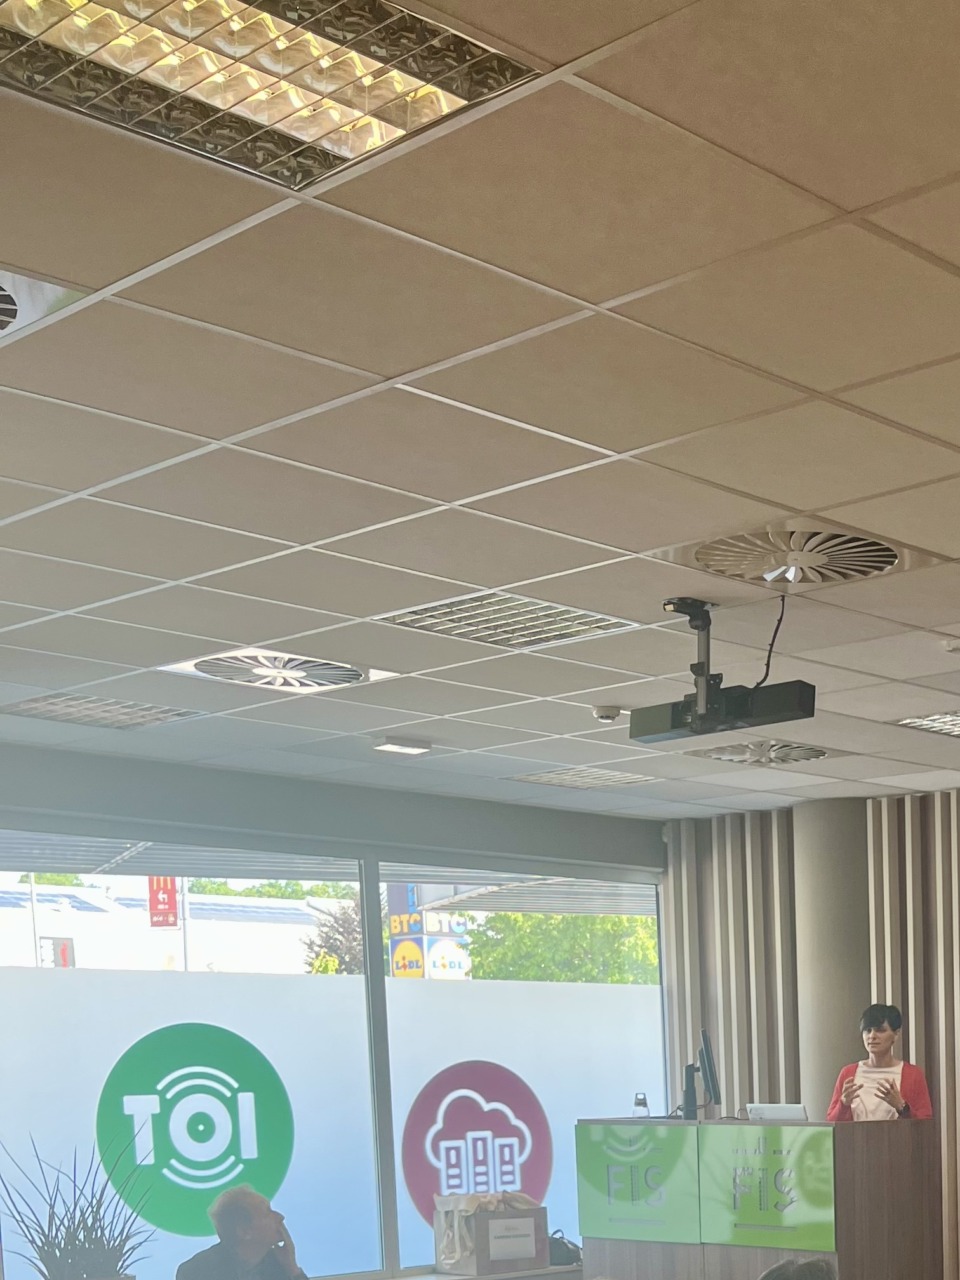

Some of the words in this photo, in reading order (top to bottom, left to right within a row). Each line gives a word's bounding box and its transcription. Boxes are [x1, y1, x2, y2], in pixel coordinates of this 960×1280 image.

[390, 913, 422, 934] BTC
[425, 911, 466, 934] BTC
[123, 1091, 258, 1166] TOI
[606, 1163, 667, 1209] FIS
[732, 1166, 798, 1213] FIS
